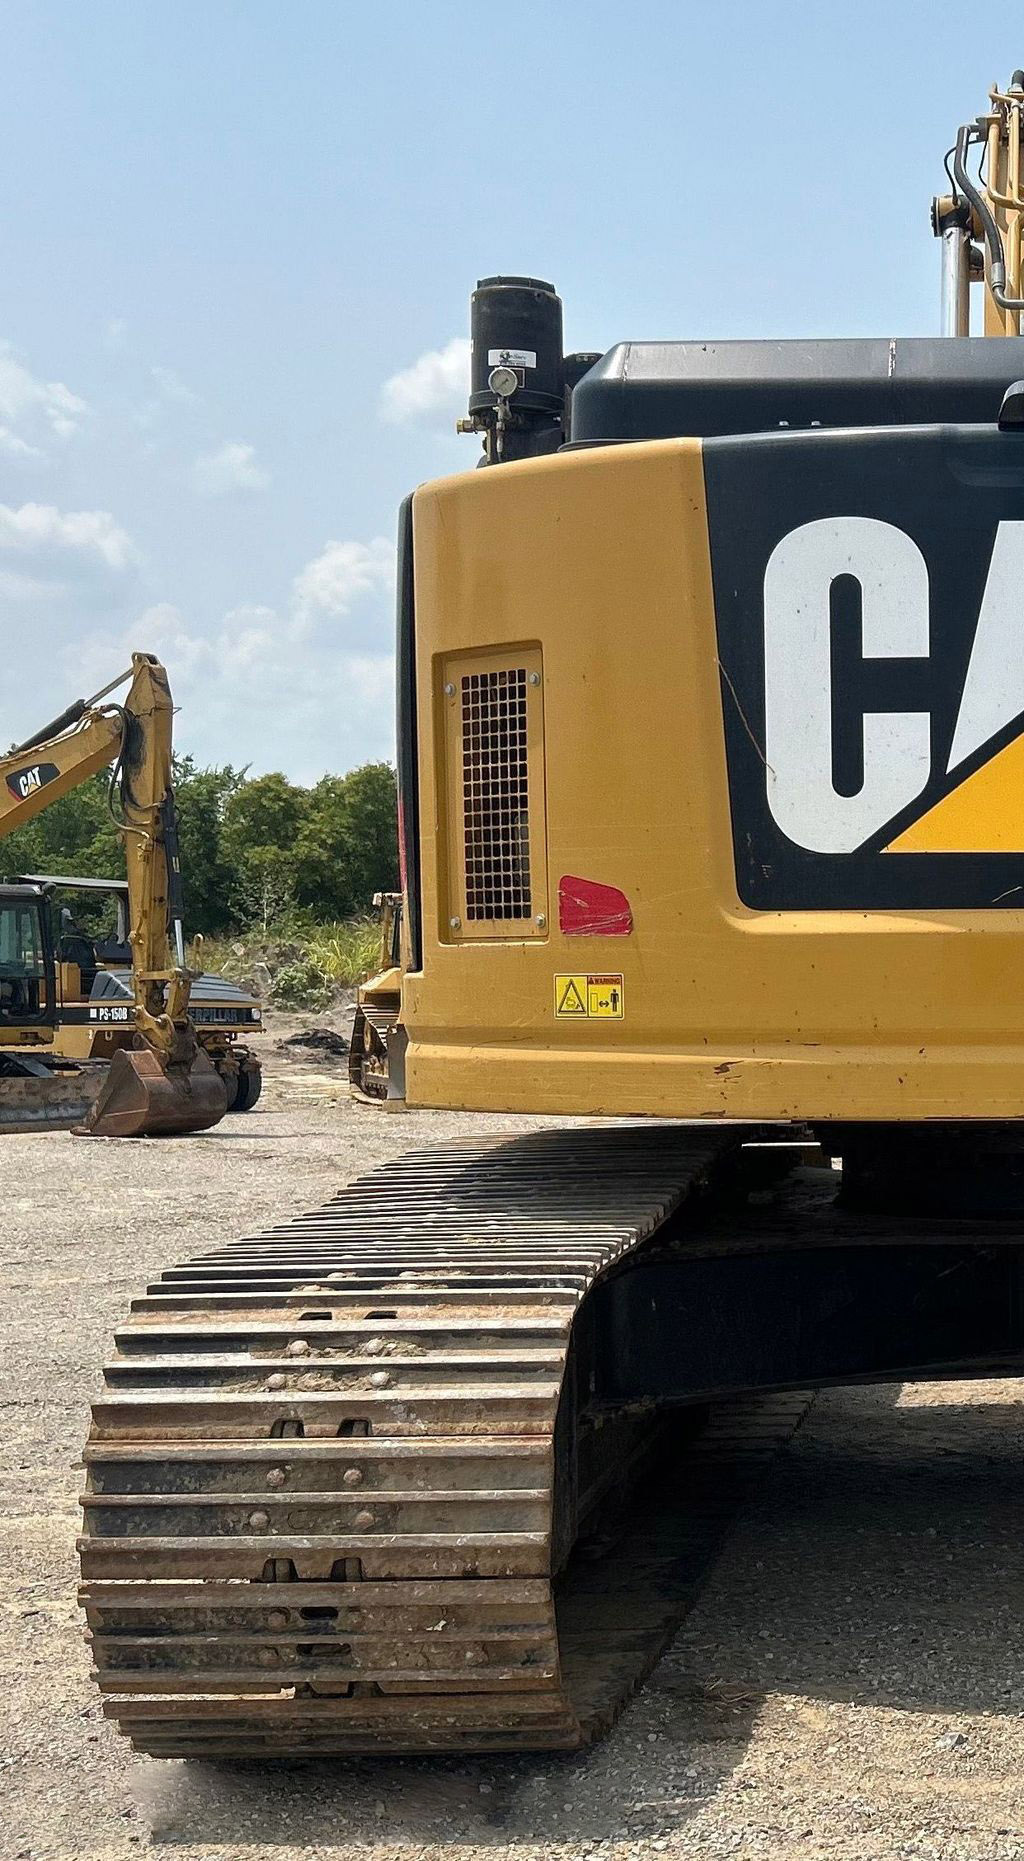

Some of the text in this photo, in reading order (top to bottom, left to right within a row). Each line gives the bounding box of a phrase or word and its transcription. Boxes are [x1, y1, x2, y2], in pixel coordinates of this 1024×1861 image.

[19, 766, 42, 797] CAT
[594, 977, 621, 985] WARNING
[99, 1007, 128, 1021] PS-150B
